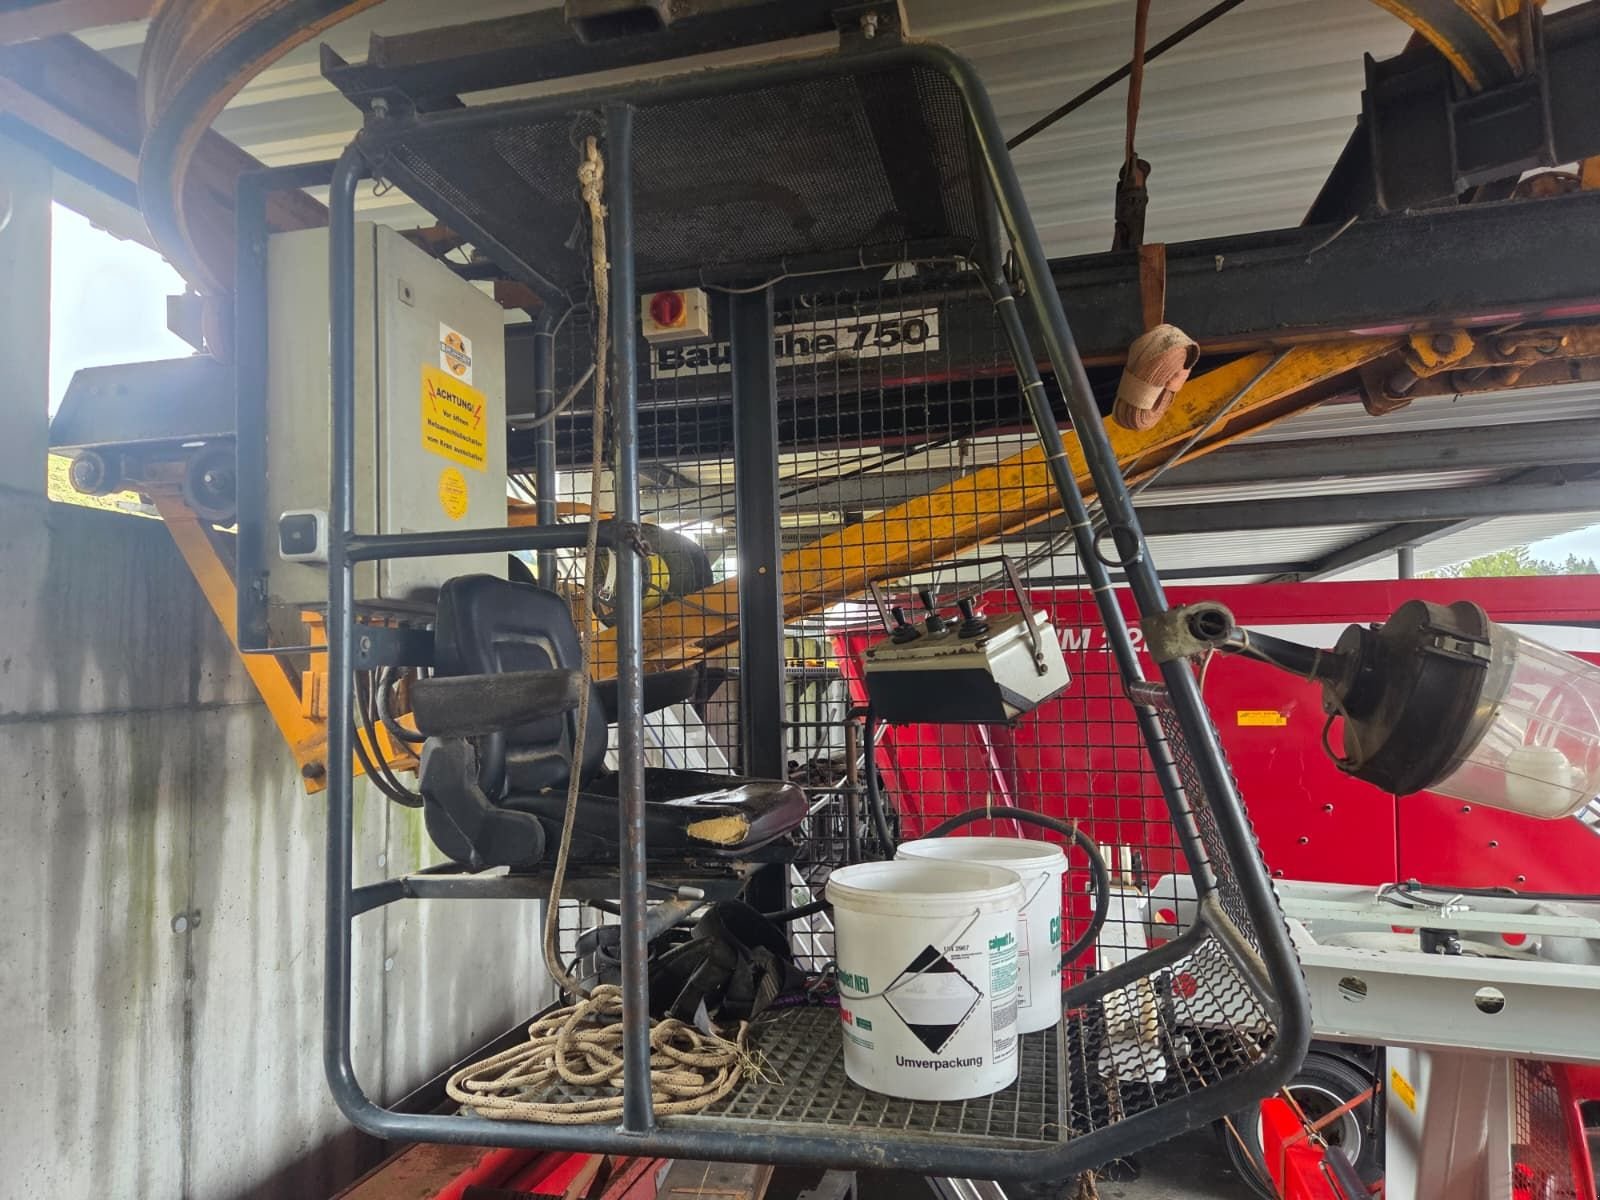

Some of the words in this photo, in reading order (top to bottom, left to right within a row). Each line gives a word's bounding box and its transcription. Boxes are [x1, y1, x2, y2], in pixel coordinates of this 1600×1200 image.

[657, 331, 838, 371] Bauihe
[847, 319, 930, 351] 750
[436, 387, 475, 413] ACHTUNG!
[854, 974, 870, 994] NEU
[896, 1055, 983, 1072] Umverpackung
